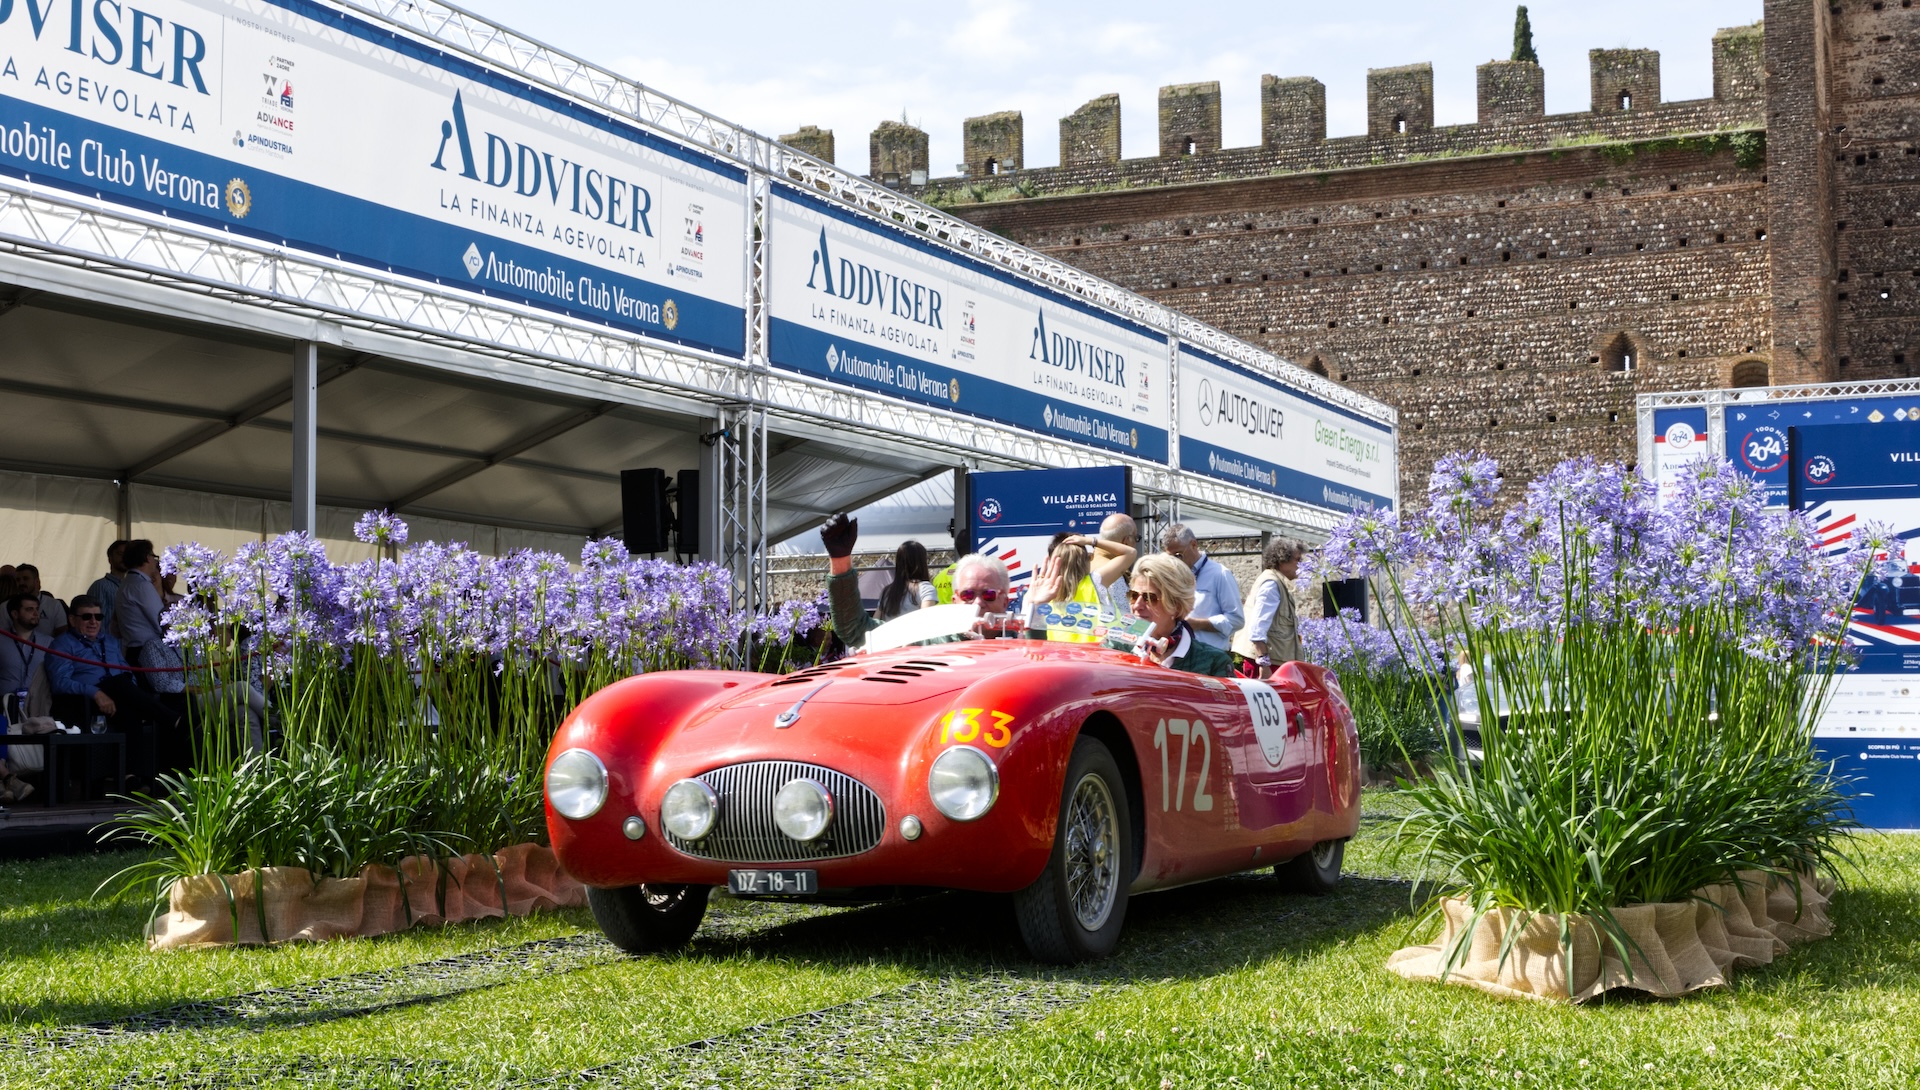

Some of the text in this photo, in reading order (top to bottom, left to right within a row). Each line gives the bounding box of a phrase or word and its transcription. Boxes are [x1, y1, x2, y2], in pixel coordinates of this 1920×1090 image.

[276, 56, 295, 67] PARTNER
[34, 66, 196, 134] AGEVOLATA
[256, 111, 295, 131] ADVANCE
[247, 133, 294, 155] APINDUSTRIA
[430, 87, 654, 239] ADDVISER
[80, 138, 135, 187] Club
[140, 153, 220, 210] Verona
[440, 188, 646, 268] LA FINANZA AGEVOLATA
[485, 251, 575, 302] Automobile
[578, 276, 610, 312] Club
[612, 286, 660, 325] Verona
[806, 224, 944, 331] ADDVISER
[812, 303, 939, 356] LA FINANZA AGEVOLATA
[1029, 306, 1127, 389] ADDVISER
[839, 350, 895, 386] Automobile
[896, 364, 917, 391] Club
[917, 370, 949, 400] Verona
[1033, 371, 1124, 410] LA FINANZA AGEVOLATA
[1053, 409, 1131, 447] Automobile Club Verona
[1314, 419, 1338, 452] Green
[1339, 428, 1366, 463] Energy
[1672, 430, 1688, 444] 2024
[1755, 425, 1775, 433] 1000
[1748, 436, 1782, 462] 2024
[1215, 453, 1271, 486] Automobile Club Verona
[1809, 461, 1830, 478] 2024
[981, 503, 998, 518] 2024
[1042, 492, 1117, 505] VILLAFRANCA
[939, 708, 1016, 748] 133
[1252, 691, 1280, 728] 133
[1153, 717, 1214, 813] 172
[737, 871, 808, 891] DZ-18-11
